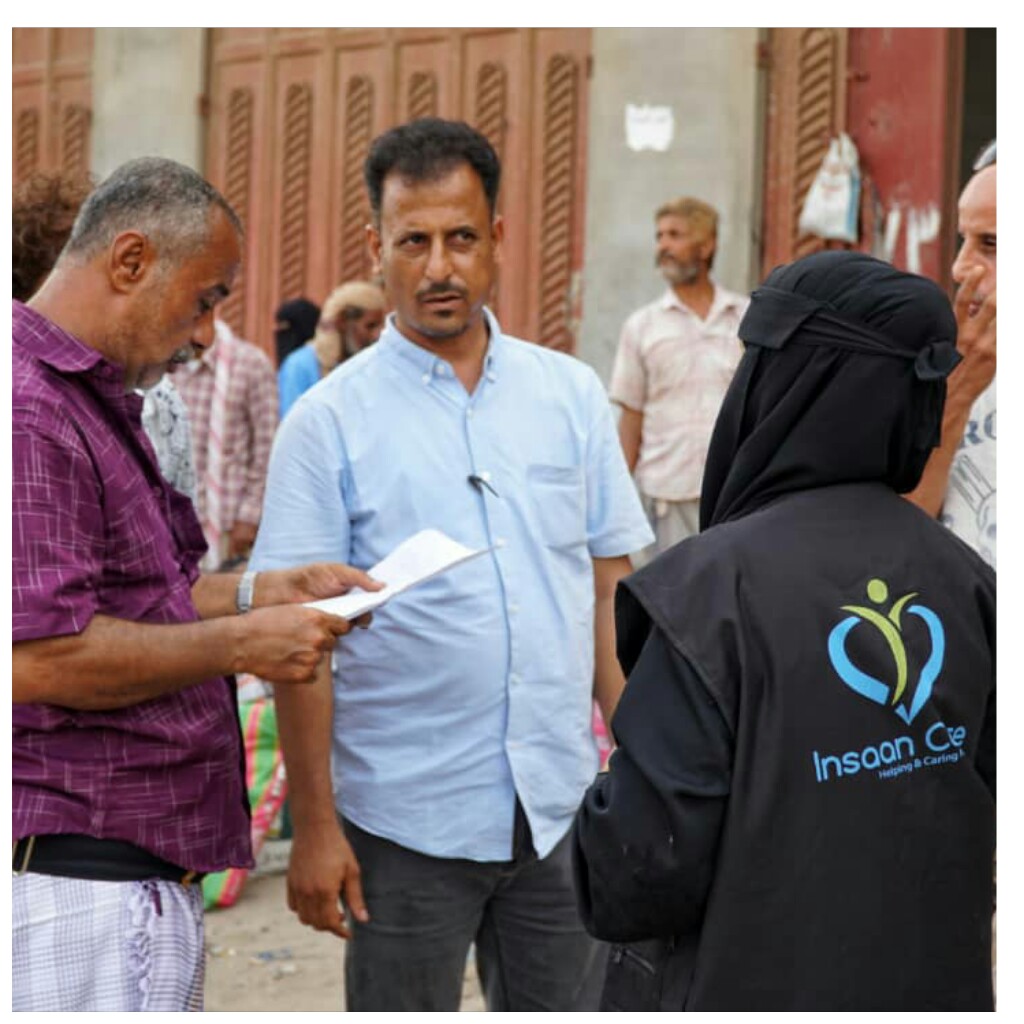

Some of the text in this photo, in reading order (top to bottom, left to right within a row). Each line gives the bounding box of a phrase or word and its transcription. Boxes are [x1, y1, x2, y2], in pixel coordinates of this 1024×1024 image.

[813, 735, 914, 783] Insaan
[879, 762, 913, 780] Helping
[914, 757, 922, 769] &
[923, 752, 958, 767] Caring
